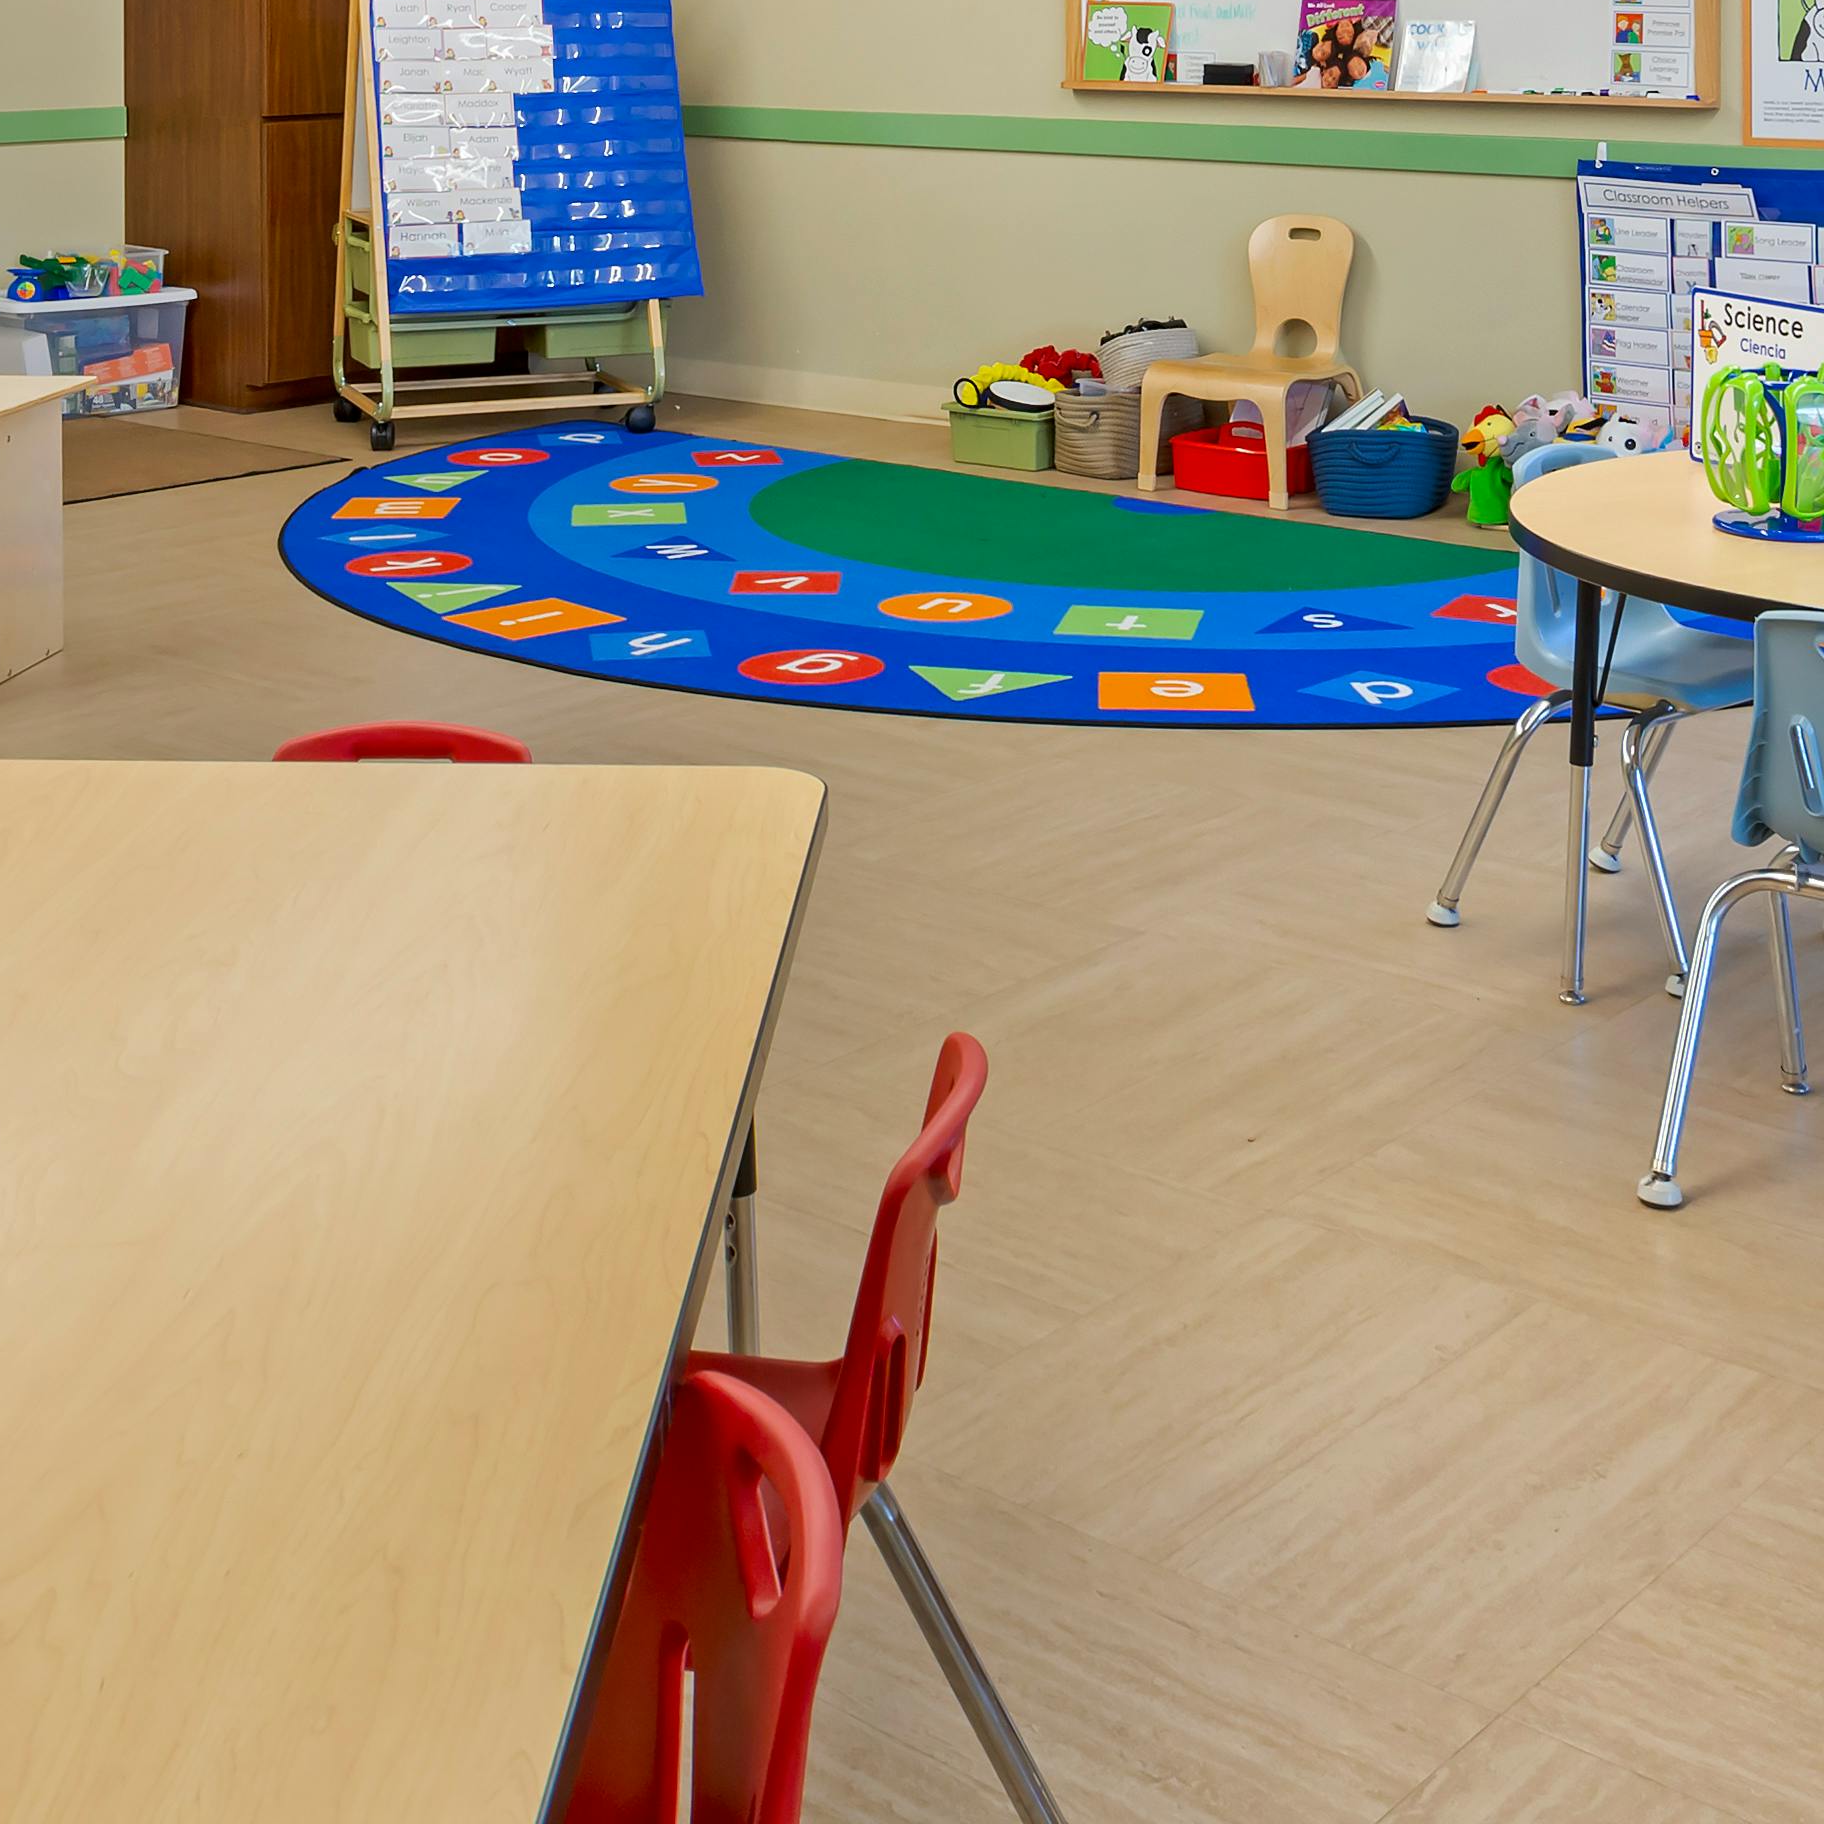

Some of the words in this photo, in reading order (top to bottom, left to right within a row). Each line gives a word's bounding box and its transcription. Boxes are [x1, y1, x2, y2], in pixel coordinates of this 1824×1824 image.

[395, 3, 420, 13] Leah
[446, 4, 471, 14] Ryan
[490, 3, 526, 14] Cooper
[1307, 3, 1366, 27] Different
[388, 33, 431, 45] Leighton
[399, 67, 429, 76] Jonah
[504, 66, 533, 77] Wyatt
[458, 98, 499, 108] Maddox
[403, 133, 429, 143] Elijah
[468, 134, 500, 143] Adam
[406, 198, 441, 207] William
[460, 196, 513, 206] Mackenzie
[1603, 188, 1674, 206] Classroom
[1677, 194, 1730, 211] Helpers
[401, 231, 447, 241] Hannah
[1755, 236, 1775, 247] Song
[1777, 237, 1807, 247] Leader
[1616, 264, 1655, 274] Classroom
[1616, 303, 1651, 313] Calendar
[1723, 303, 1803, 339] Science
[1740, 338, 1786, 360] Ciencia
[1617, 377, 1648, 386] Weather
[479, 452, 523, 462] o
